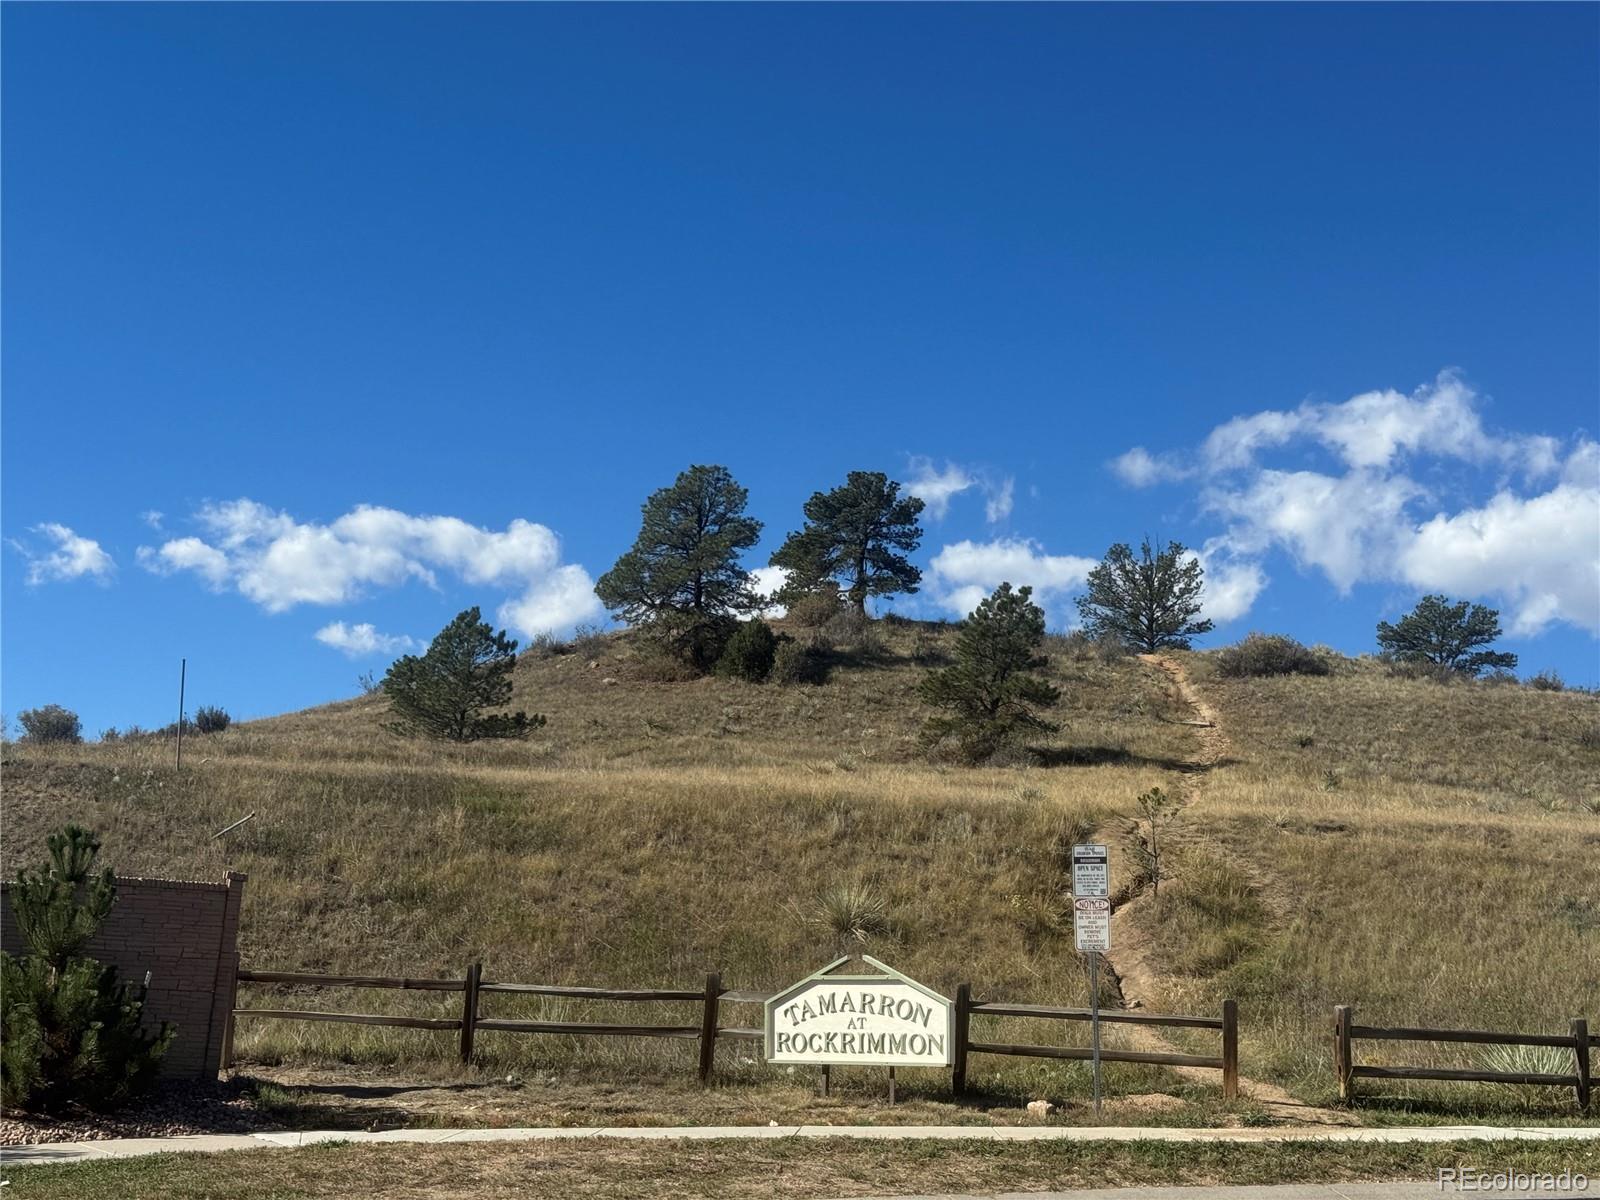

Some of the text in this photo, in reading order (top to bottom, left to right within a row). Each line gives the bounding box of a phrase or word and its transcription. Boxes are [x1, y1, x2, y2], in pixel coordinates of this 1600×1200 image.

[784, 991, 932, 1028] TAMARRON
[847, 1017, 868, 1030] AT
[776, 1032, 944, 1056] ROCKRIMMON
